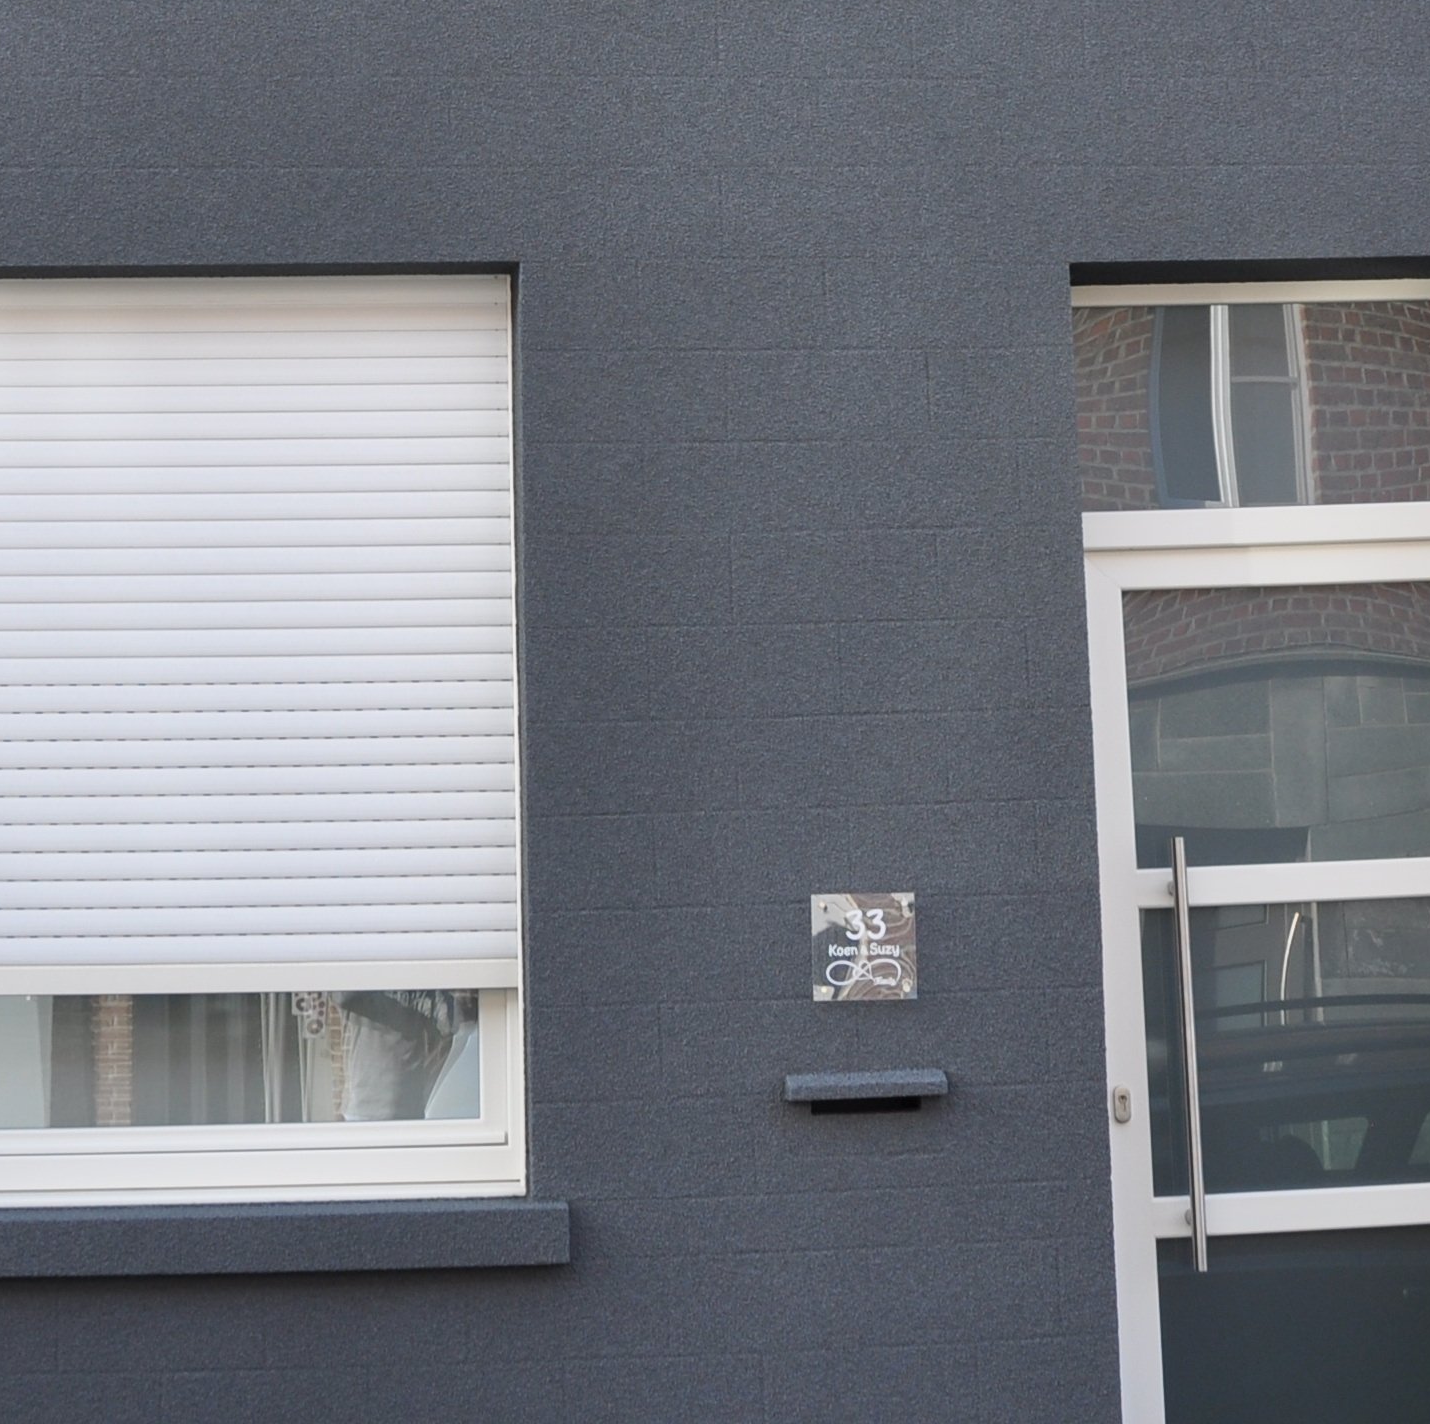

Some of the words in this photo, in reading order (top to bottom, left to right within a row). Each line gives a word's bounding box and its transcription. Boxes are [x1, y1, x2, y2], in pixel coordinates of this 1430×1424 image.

[846, 908, 886, 940] 33
[828, 944, 857, 957] Koen
[870, 942, 899, 957] Suzy
